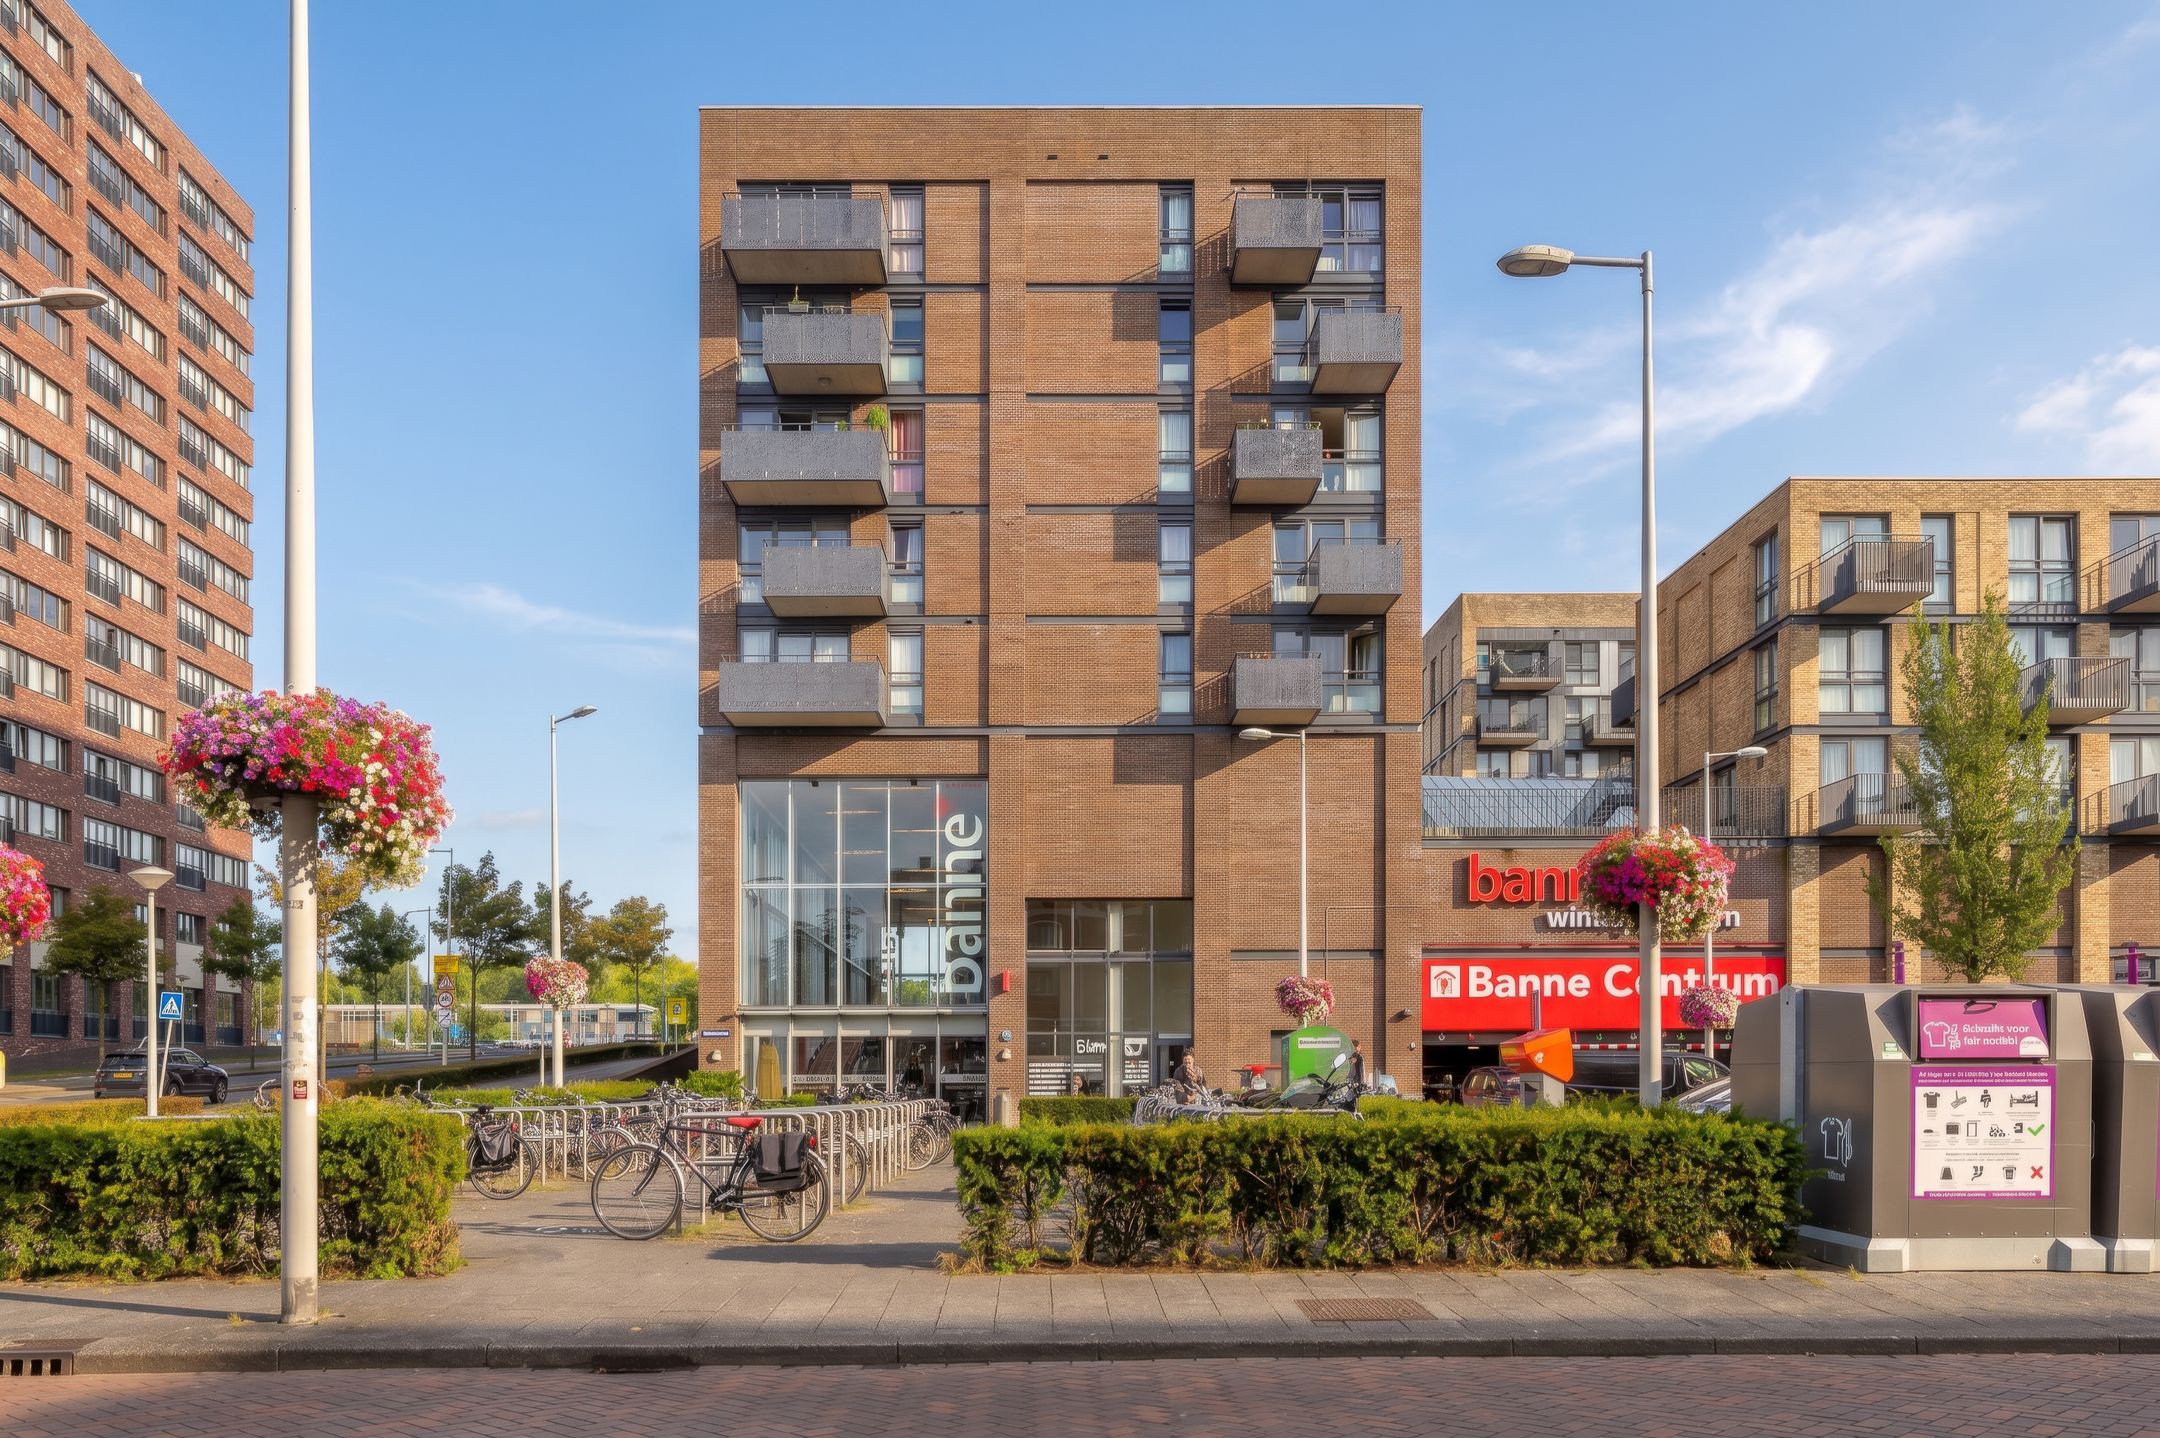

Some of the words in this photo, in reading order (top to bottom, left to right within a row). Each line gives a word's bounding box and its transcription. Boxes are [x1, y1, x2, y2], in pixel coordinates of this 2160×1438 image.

[1469, 852, 1584, 902] ban
[945, 813, 983, 993] banne
[1468, 965, 1591, 998] Banne
[1603, 963, 1779, 997] Cntum
